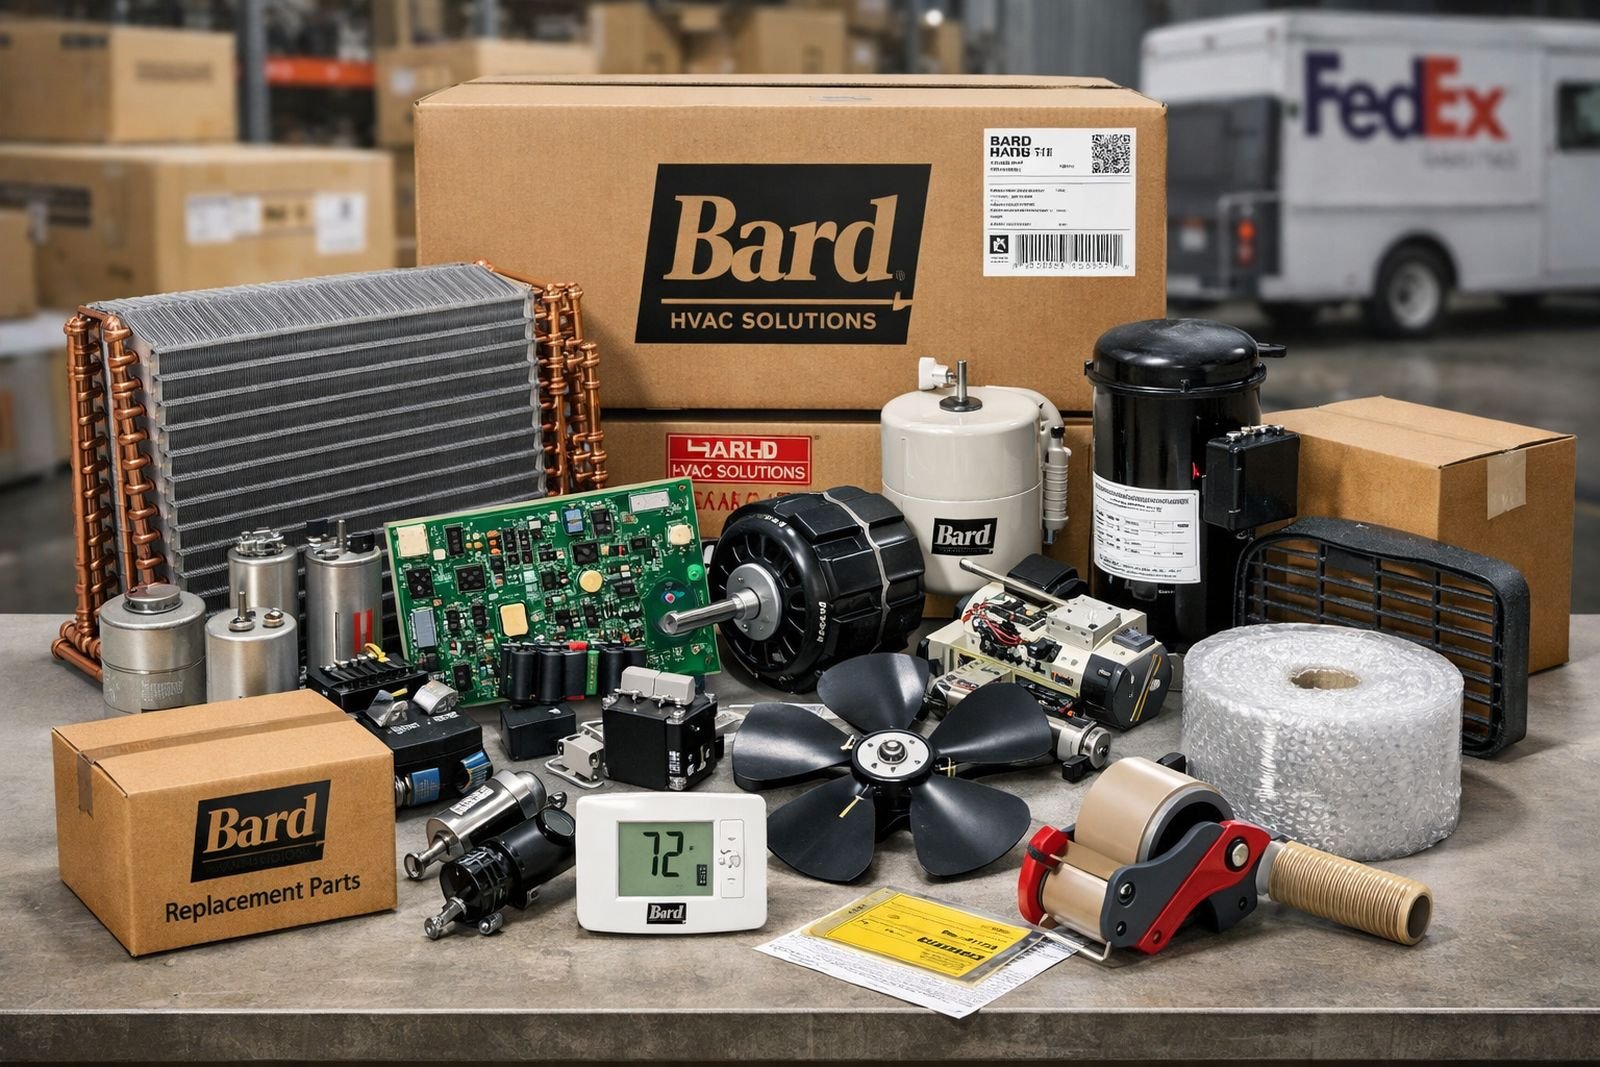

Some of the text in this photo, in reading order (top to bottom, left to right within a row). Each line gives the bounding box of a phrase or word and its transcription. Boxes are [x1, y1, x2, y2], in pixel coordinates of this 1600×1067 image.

[1304, 50, 1508, 141] FedEx
[990, 135, 1032, 147] BARD
[663, 194, 898, 283] Bard
[670, 311, 877, 330] HVAC SOLUTIONS
[716, 465, 806, 480] SOLUTIONS
[933, 523, 992, 546] Bard
[202, 792, 317, 854] Bard
[642, 831, 684, 878] 72
[165, 873, 361, 923] Replacement Parts
[649, 904, 685, 920] Bard
